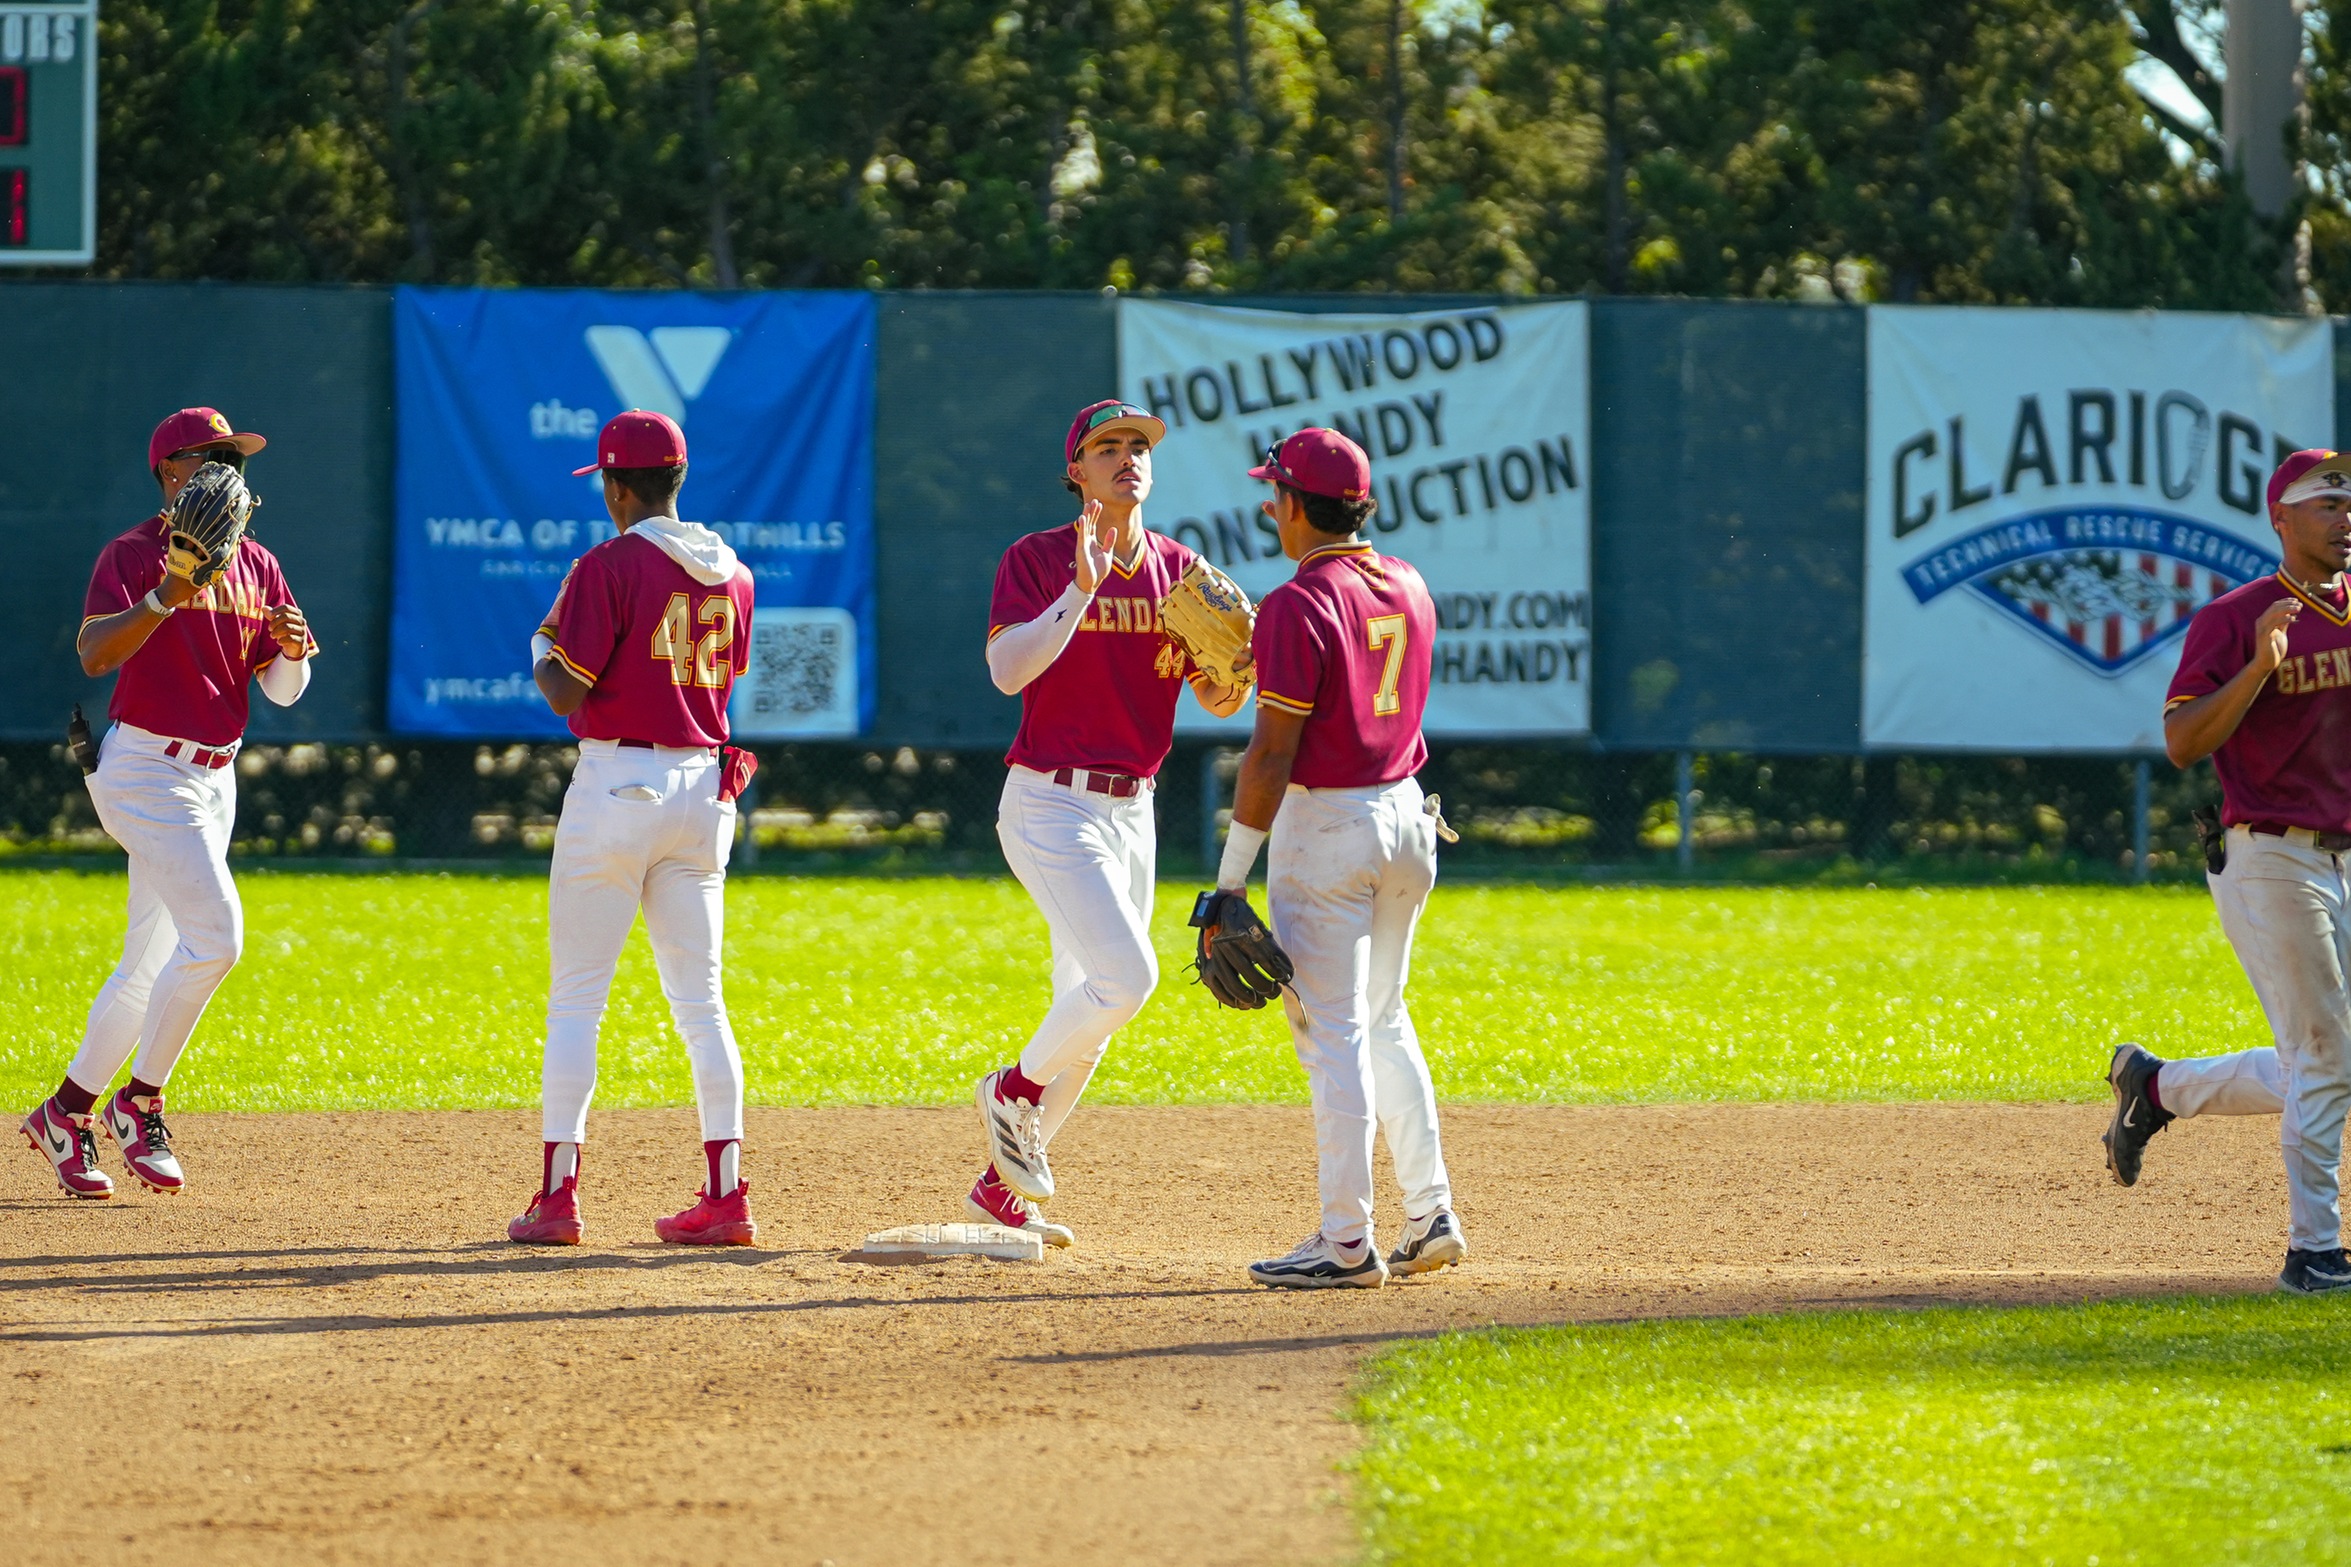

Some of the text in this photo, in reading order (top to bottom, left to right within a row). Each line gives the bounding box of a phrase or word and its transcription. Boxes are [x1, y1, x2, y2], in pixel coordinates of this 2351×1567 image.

[1142, 315, 1506, 428] HOLLYWOOD
[529, 398, 598, 439] the
[1248, 388, 1446, 486] HNDY
[424, 517, 526, 547] YMCA
[531, 518, 580, 548] OF
[1913, 520, 2056, 591] TECHNICAL
[2064, 515, 2163, 543] RESCUE
[1197, 582, 1232, 612] Rawlings
[650, 591, 737, 690] 42
[1153, 642, 1187, 680] 44
[1366, 612, 1409, 717] 7
